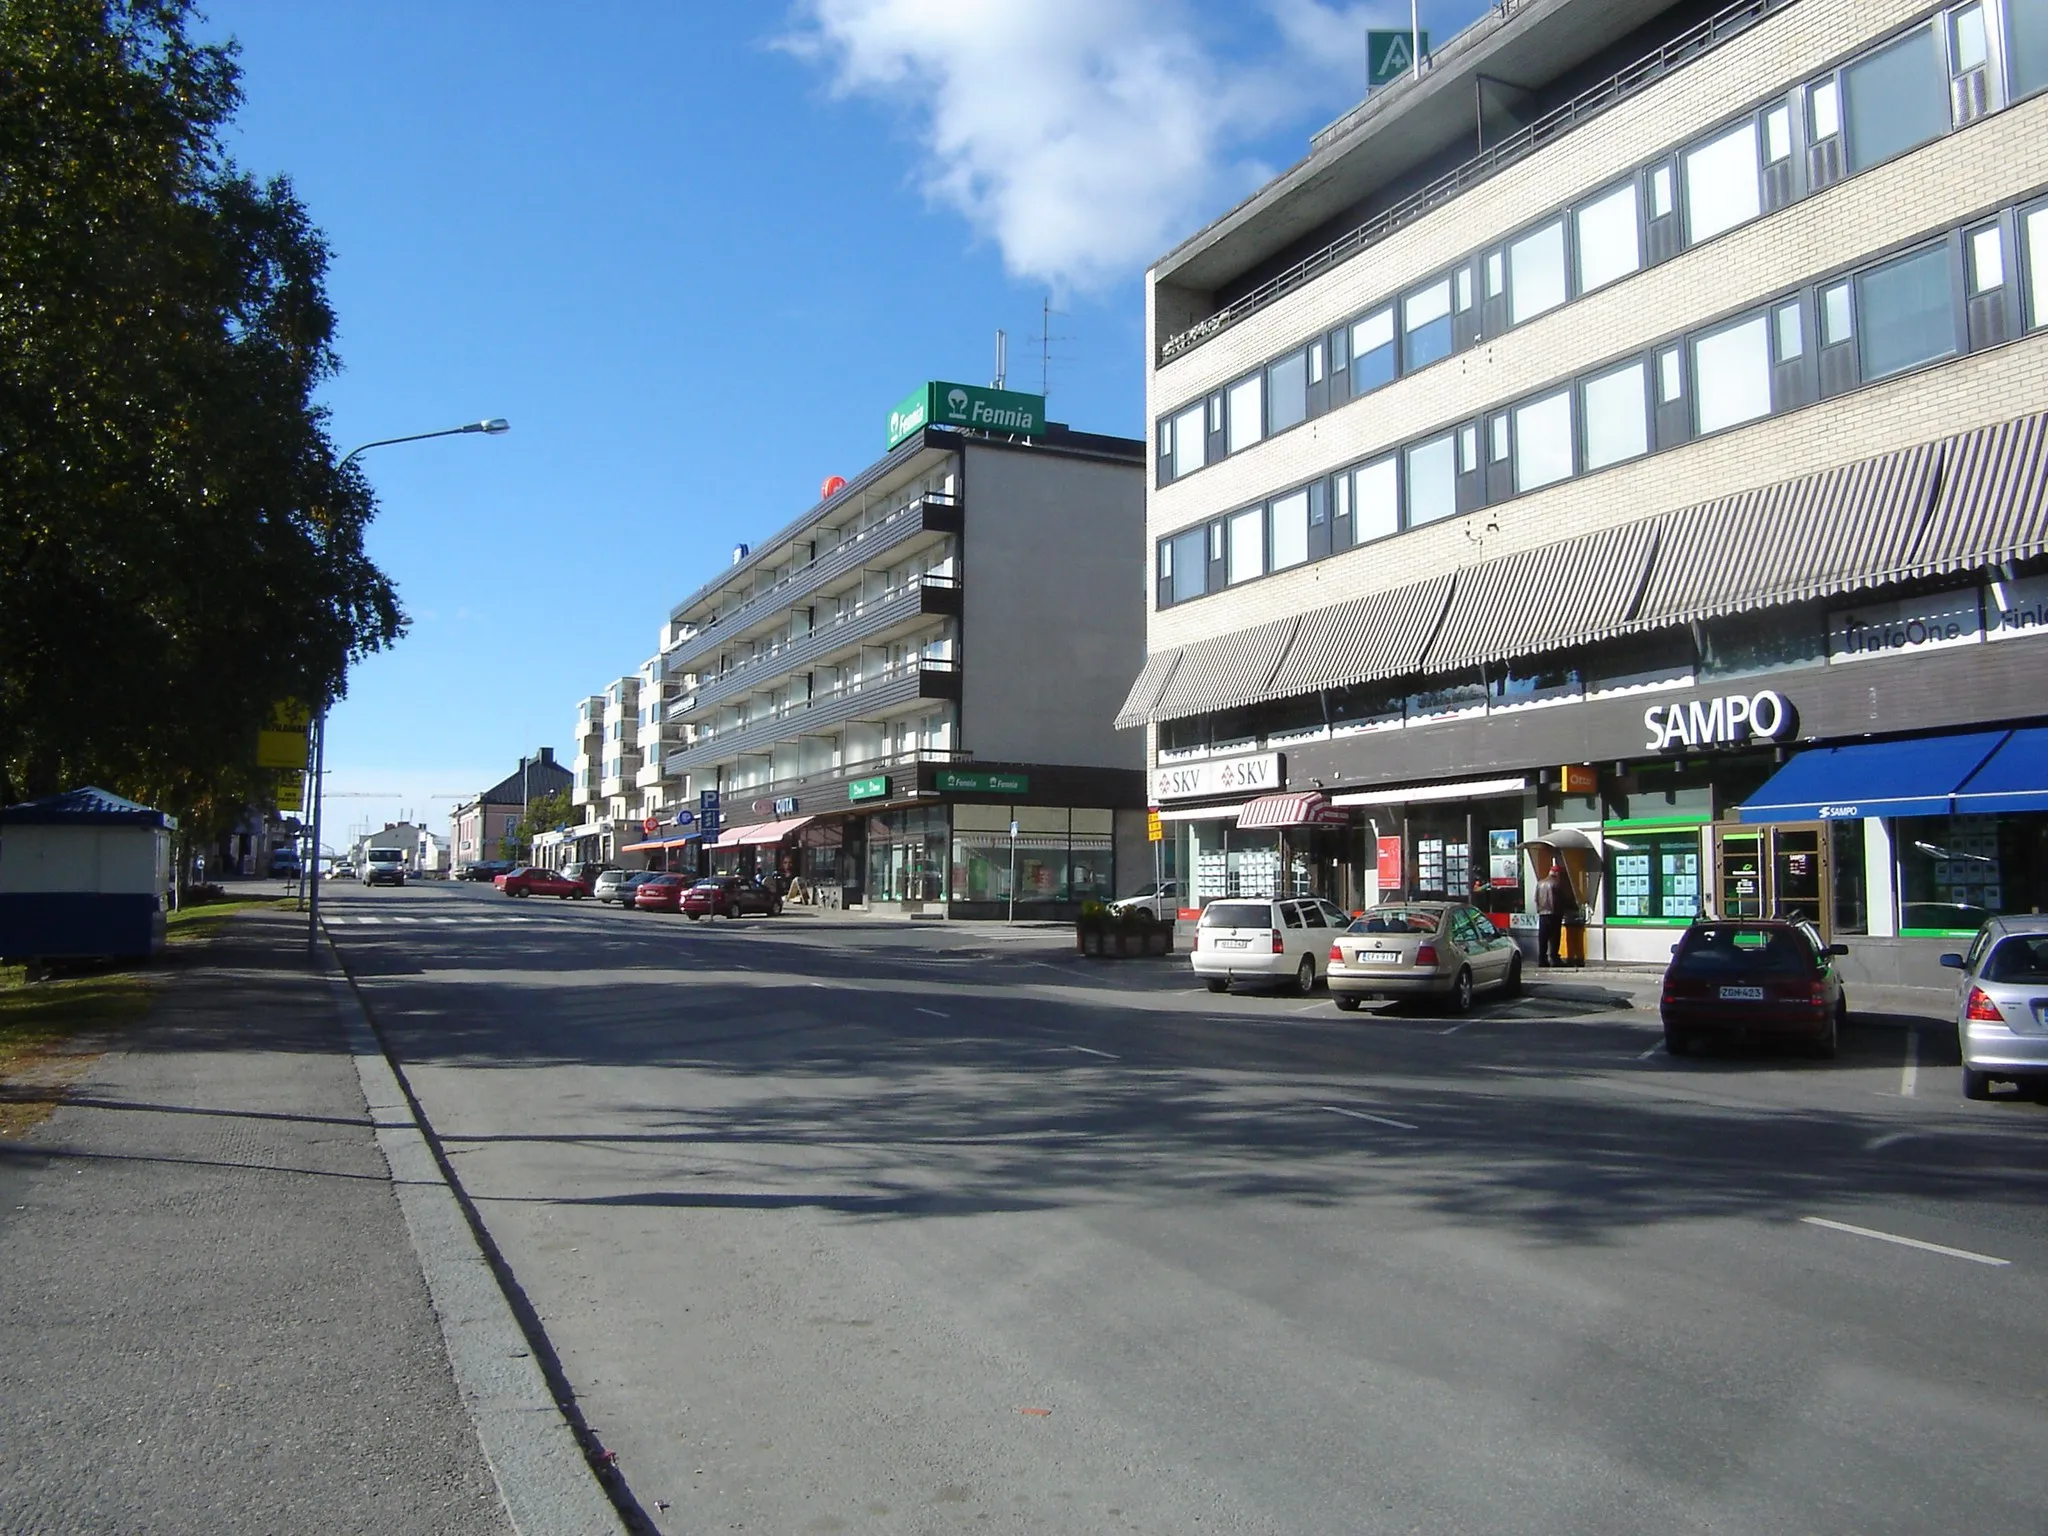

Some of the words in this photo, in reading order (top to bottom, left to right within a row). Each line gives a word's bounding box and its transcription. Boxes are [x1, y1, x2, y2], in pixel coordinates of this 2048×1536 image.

[972, 401, 1033, 428] Fennia
[1644, 689, 1782, 750] SAMPO
[1173, 769, 1200, 793] SKV
[1237, 760, 1268, 785] SKV
[703, 791, 717, 808] P
[1830, 806, 1858, 817] SAMPO
[1520, 914, 1537, 926] SKV
